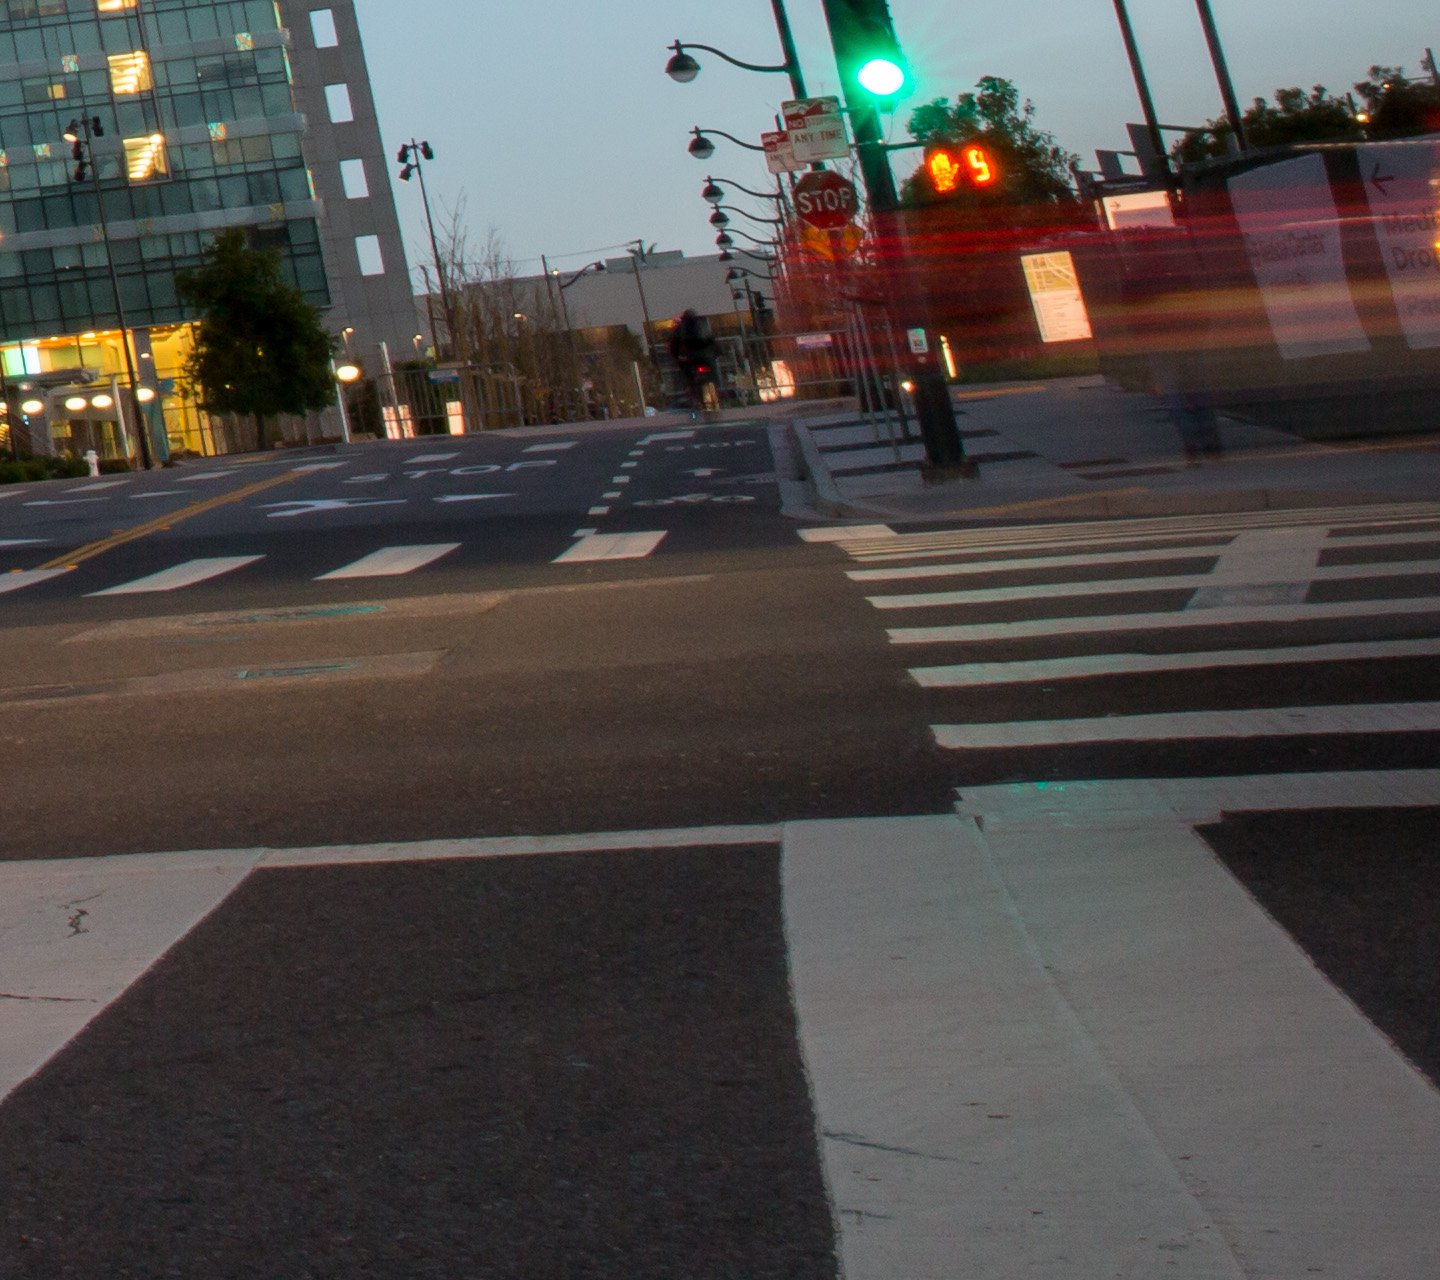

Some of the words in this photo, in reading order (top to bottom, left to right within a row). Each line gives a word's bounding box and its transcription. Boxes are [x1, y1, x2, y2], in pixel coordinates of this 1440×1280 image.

[788, 118, 805, 130] NO
[794, 132, 814, 143] ANY
[818, 128, 843, 140] TIME
[797, 187, 852, 214] STOP
[343, 459, 558, 484] STOP
